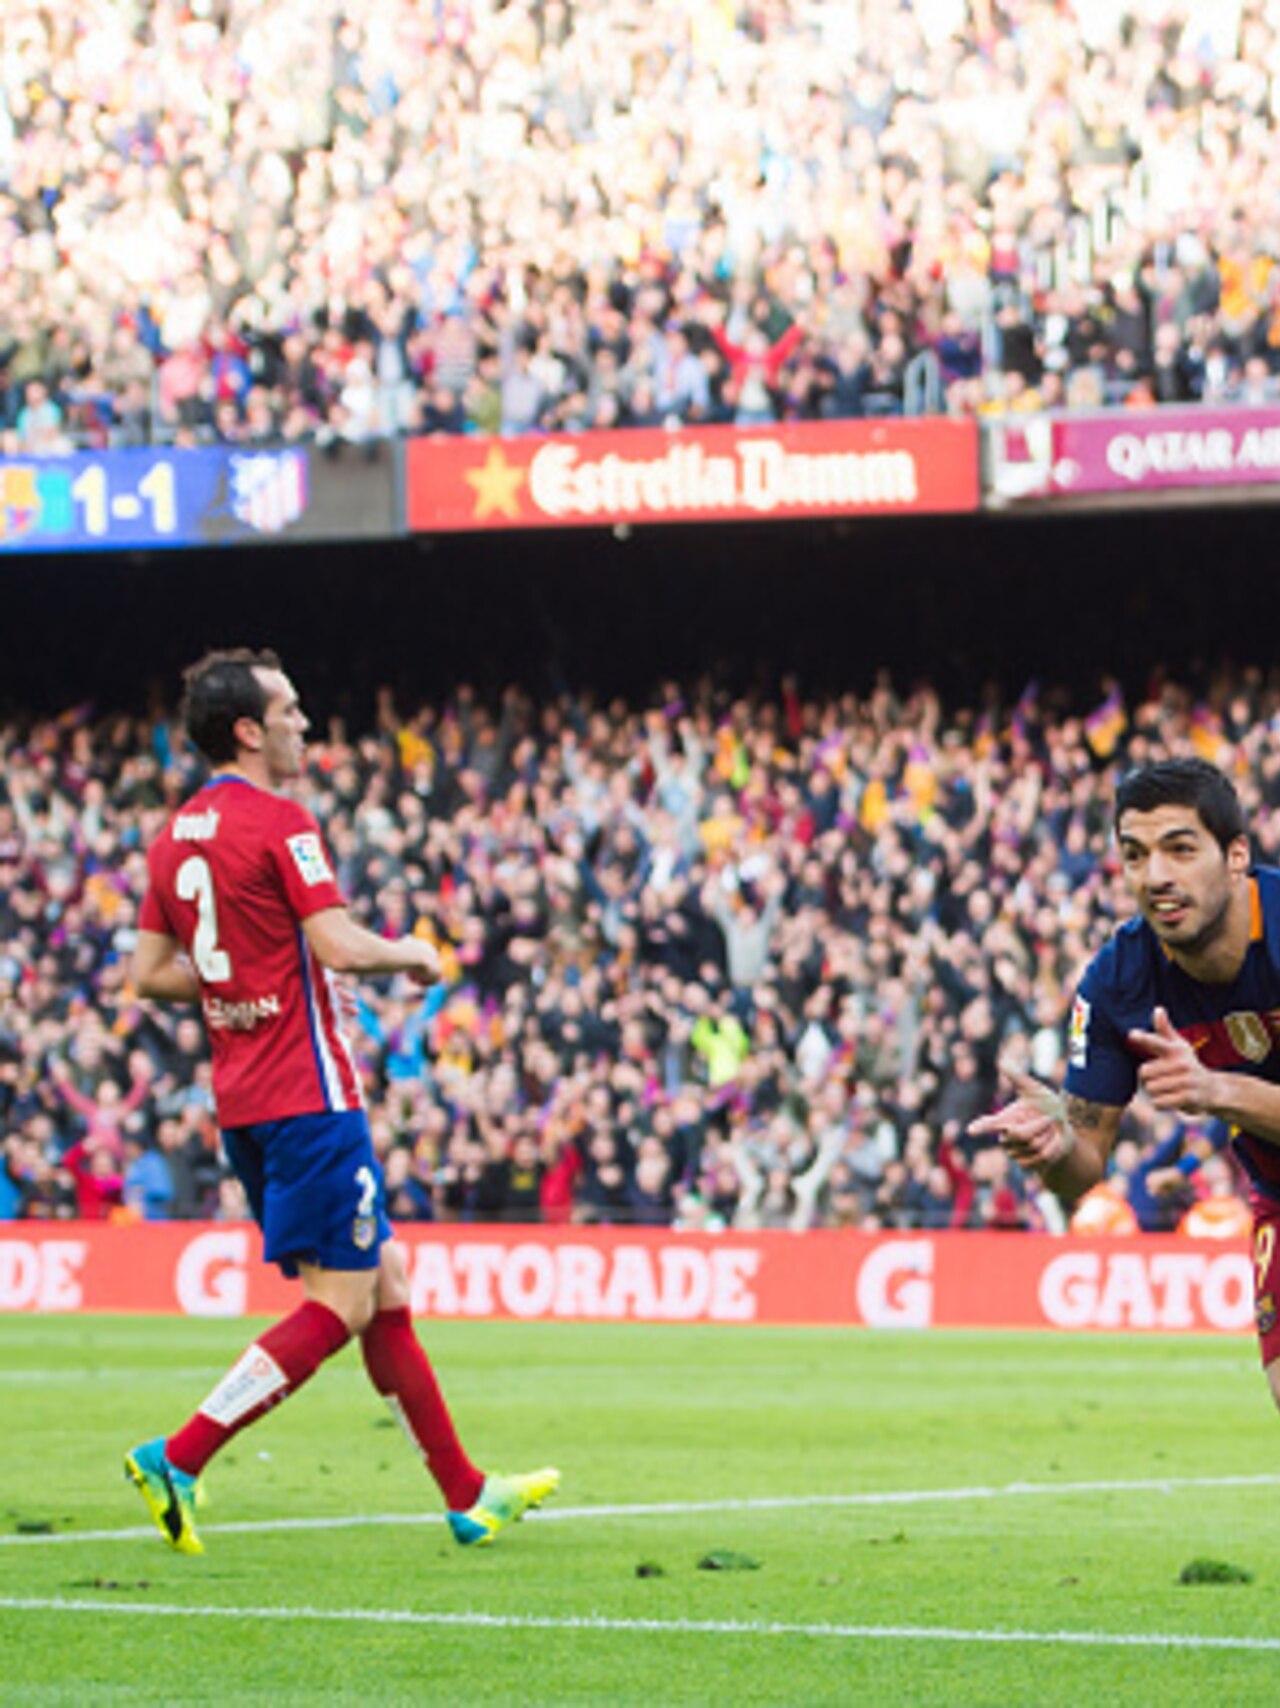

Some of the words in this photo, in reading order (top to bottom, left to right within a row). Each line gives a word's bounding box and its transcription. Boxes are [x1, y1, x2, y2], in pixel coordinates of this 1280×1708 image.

[530, 441, 735, 516] Estrella
[736, 439, 918, 512] Damm
[1106, 428, 1233, 482] QATAR
[72, 460, 178, 537] 1-1
[176, 855, 231, 982] 2
[354, 1166, 377, 1217] 2
[0, 1239, 87, 1310] DE
[174, 1229, 249, 1316] G
[397, 1242, 761, 1320] ATORADE
[856, 1238, 934, 1329] G
[1038, 1251, 1256, 1330] GATO
[1256, 1223, 1276, 1290] 9
